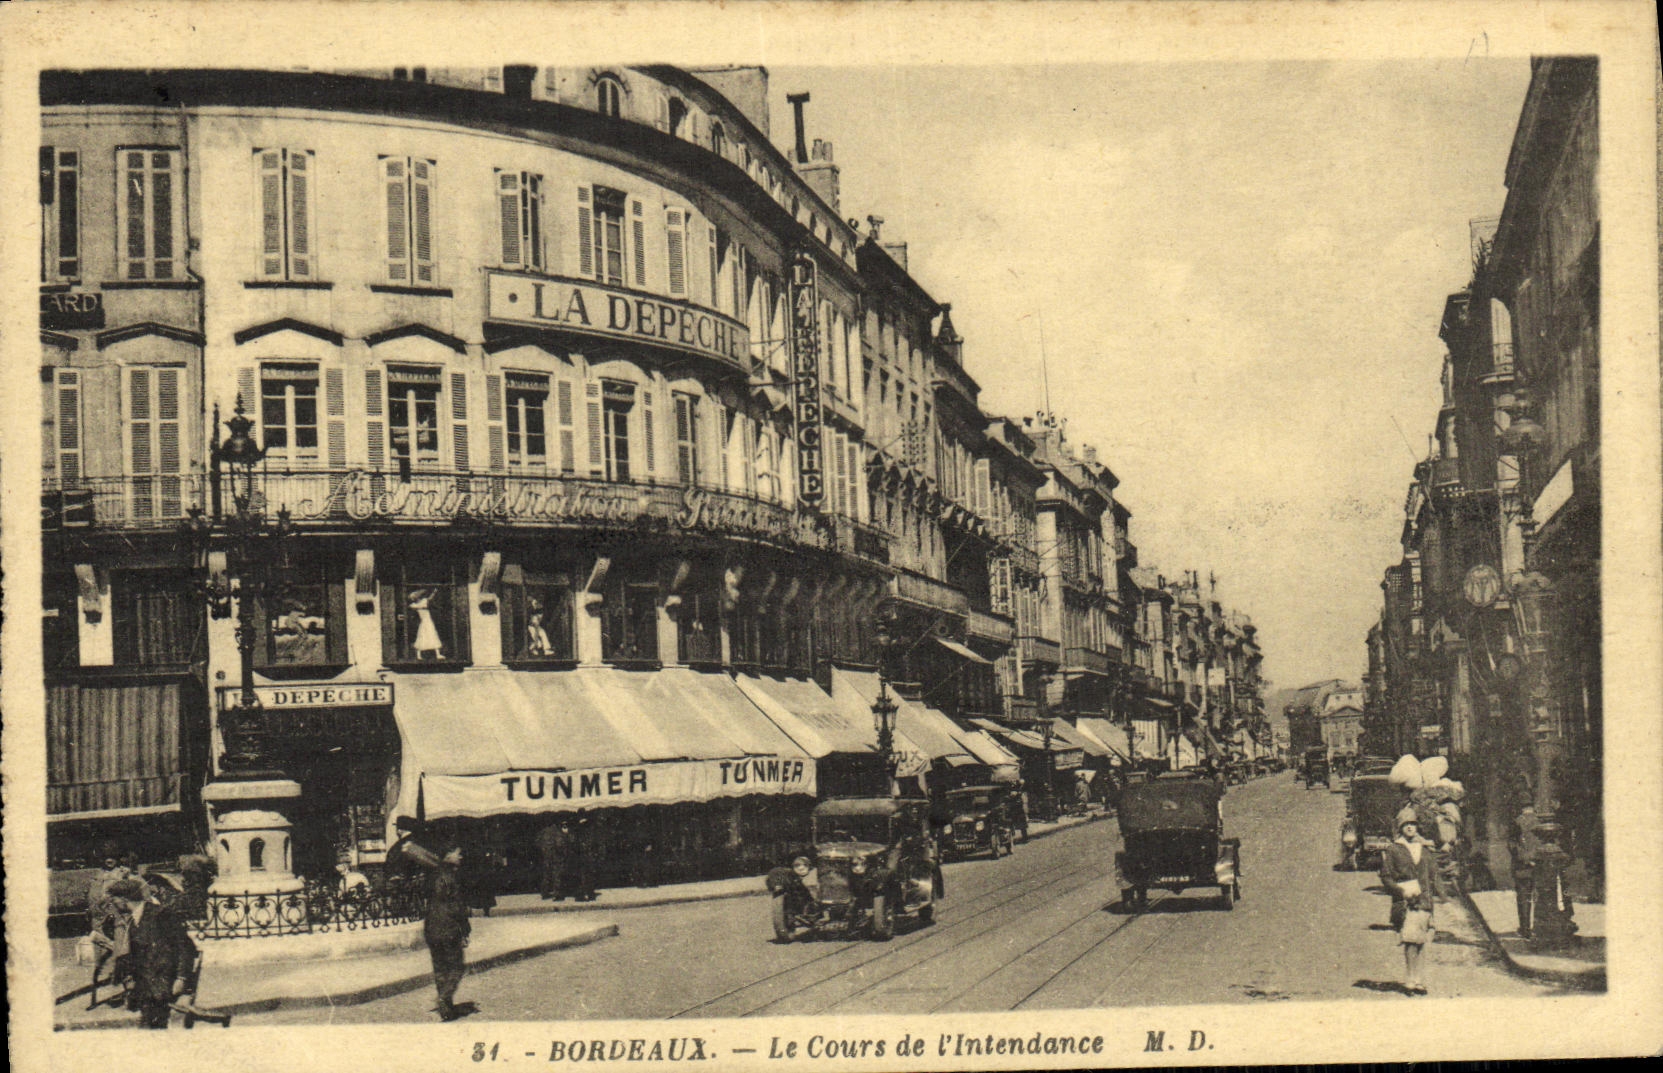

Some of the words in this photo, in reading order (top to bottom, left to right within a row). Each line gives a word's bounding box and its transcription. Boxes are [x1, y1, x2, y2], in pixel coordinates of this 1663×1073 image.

[40, 293, 98, 313] ARD
[531, 282, 593, 326] LA
[500, 769, 648, 801] TUNMER
[720, 760, 804, 785] TUNMER
